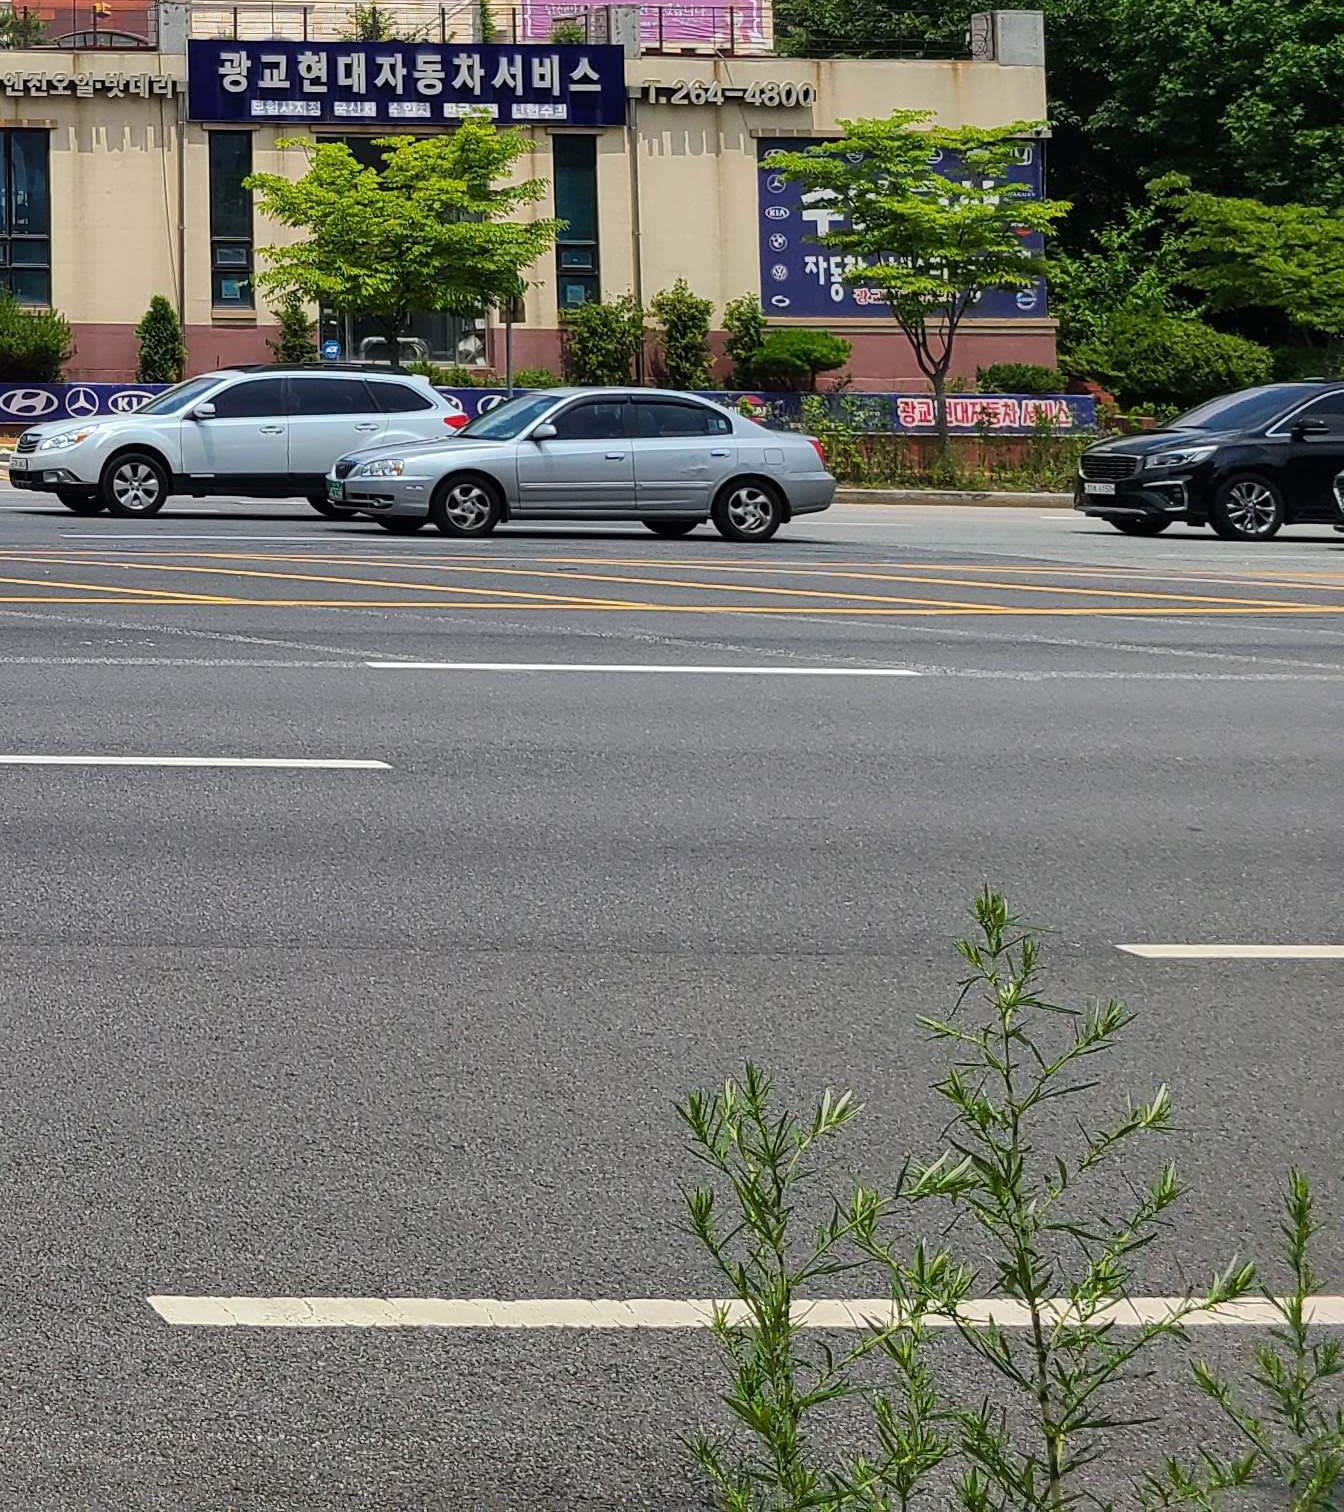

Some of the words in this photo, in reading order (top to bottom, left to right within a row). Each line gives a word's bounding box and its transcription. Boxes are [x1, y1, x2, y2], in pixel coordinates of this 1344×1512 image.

[217, 51, 602, 96] 광교현대자동차서비스
[769, 209, 786, 217] KIA
[899, 400, 934, 425] 광교
